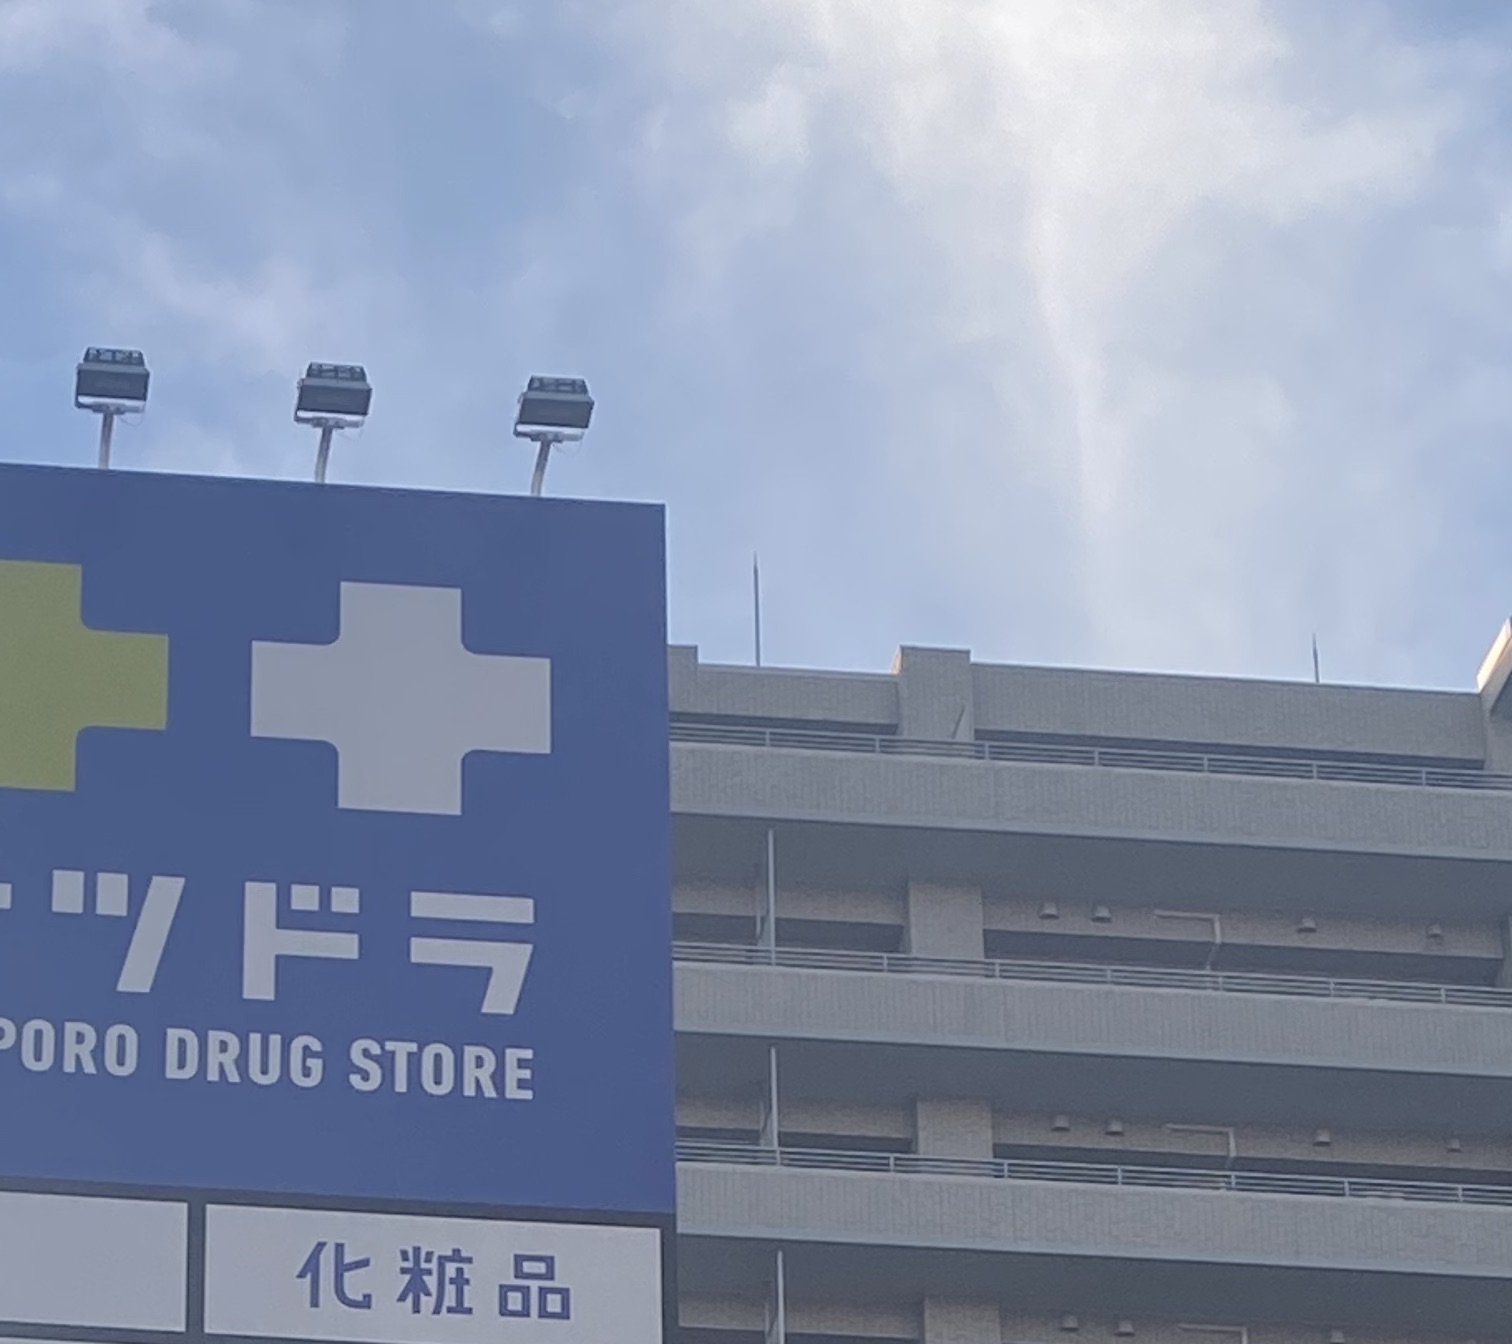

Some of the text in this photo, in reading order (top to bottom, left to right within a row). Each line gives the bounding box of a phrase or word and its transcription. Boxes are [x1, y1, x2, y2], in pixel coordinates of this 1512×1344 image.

[166, 1028, 322, 1087] DRUG
[349, 1039, 533, 1099] STORE
[296, 1242, 570, 1320] 化粧品
